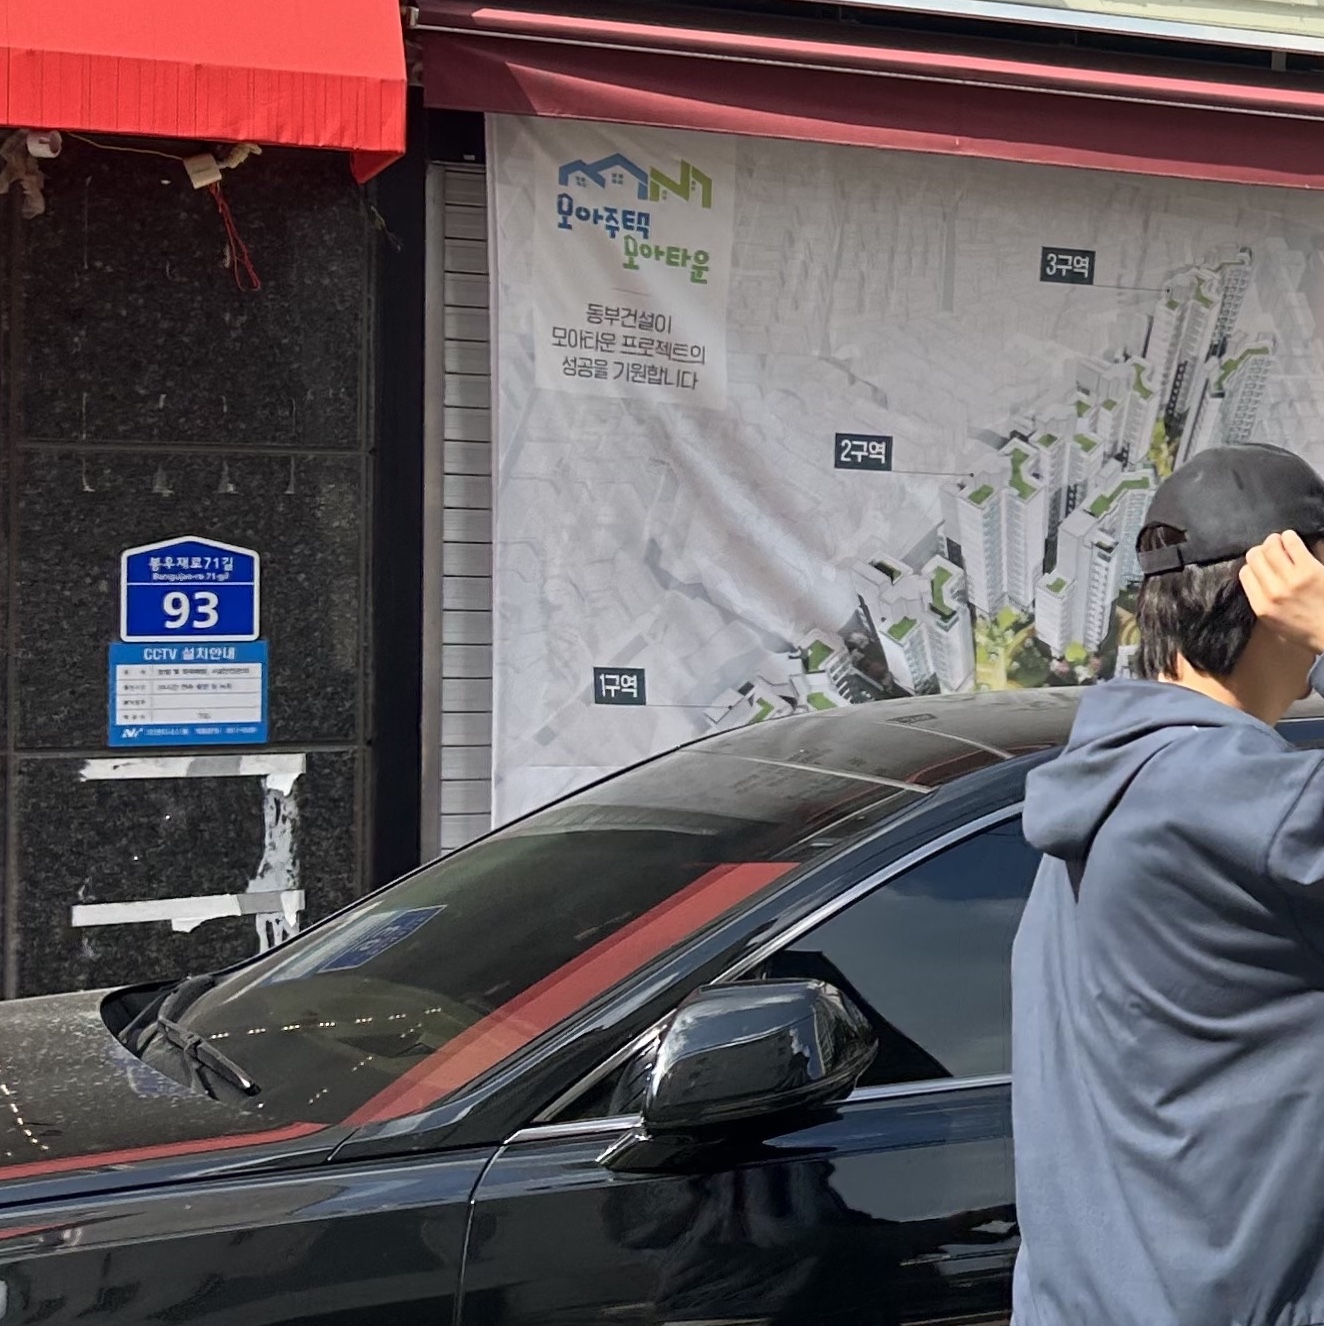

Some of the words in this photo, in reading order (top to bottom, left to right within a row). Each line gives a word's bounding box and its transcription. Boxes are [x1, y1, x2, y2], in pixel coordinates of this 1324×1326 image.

[557, 193, 650, 239] 모아주택
[623, 234, 709, 284] 모아타운
[1046, 253, 1090, 278] 3구역
[586, 303, 672, 334] 동부건설이
[552, 326, 617, 353] 모아타운
[620, 334, 706, 365] 프로젝트의
[562, 356, 609, 380] 성공을
[613, 360, 699, 390] 기원합니다
[840, 439, 886, 464] 2구역
[148, 556, 234, 571] 봉우재로71길
[163, 591, 219, 629] 93
[143, 647, 178, 661] CCTV
[182, 646, 236, 660] 설치안내
[599, 674, 638, 698] 1구역
